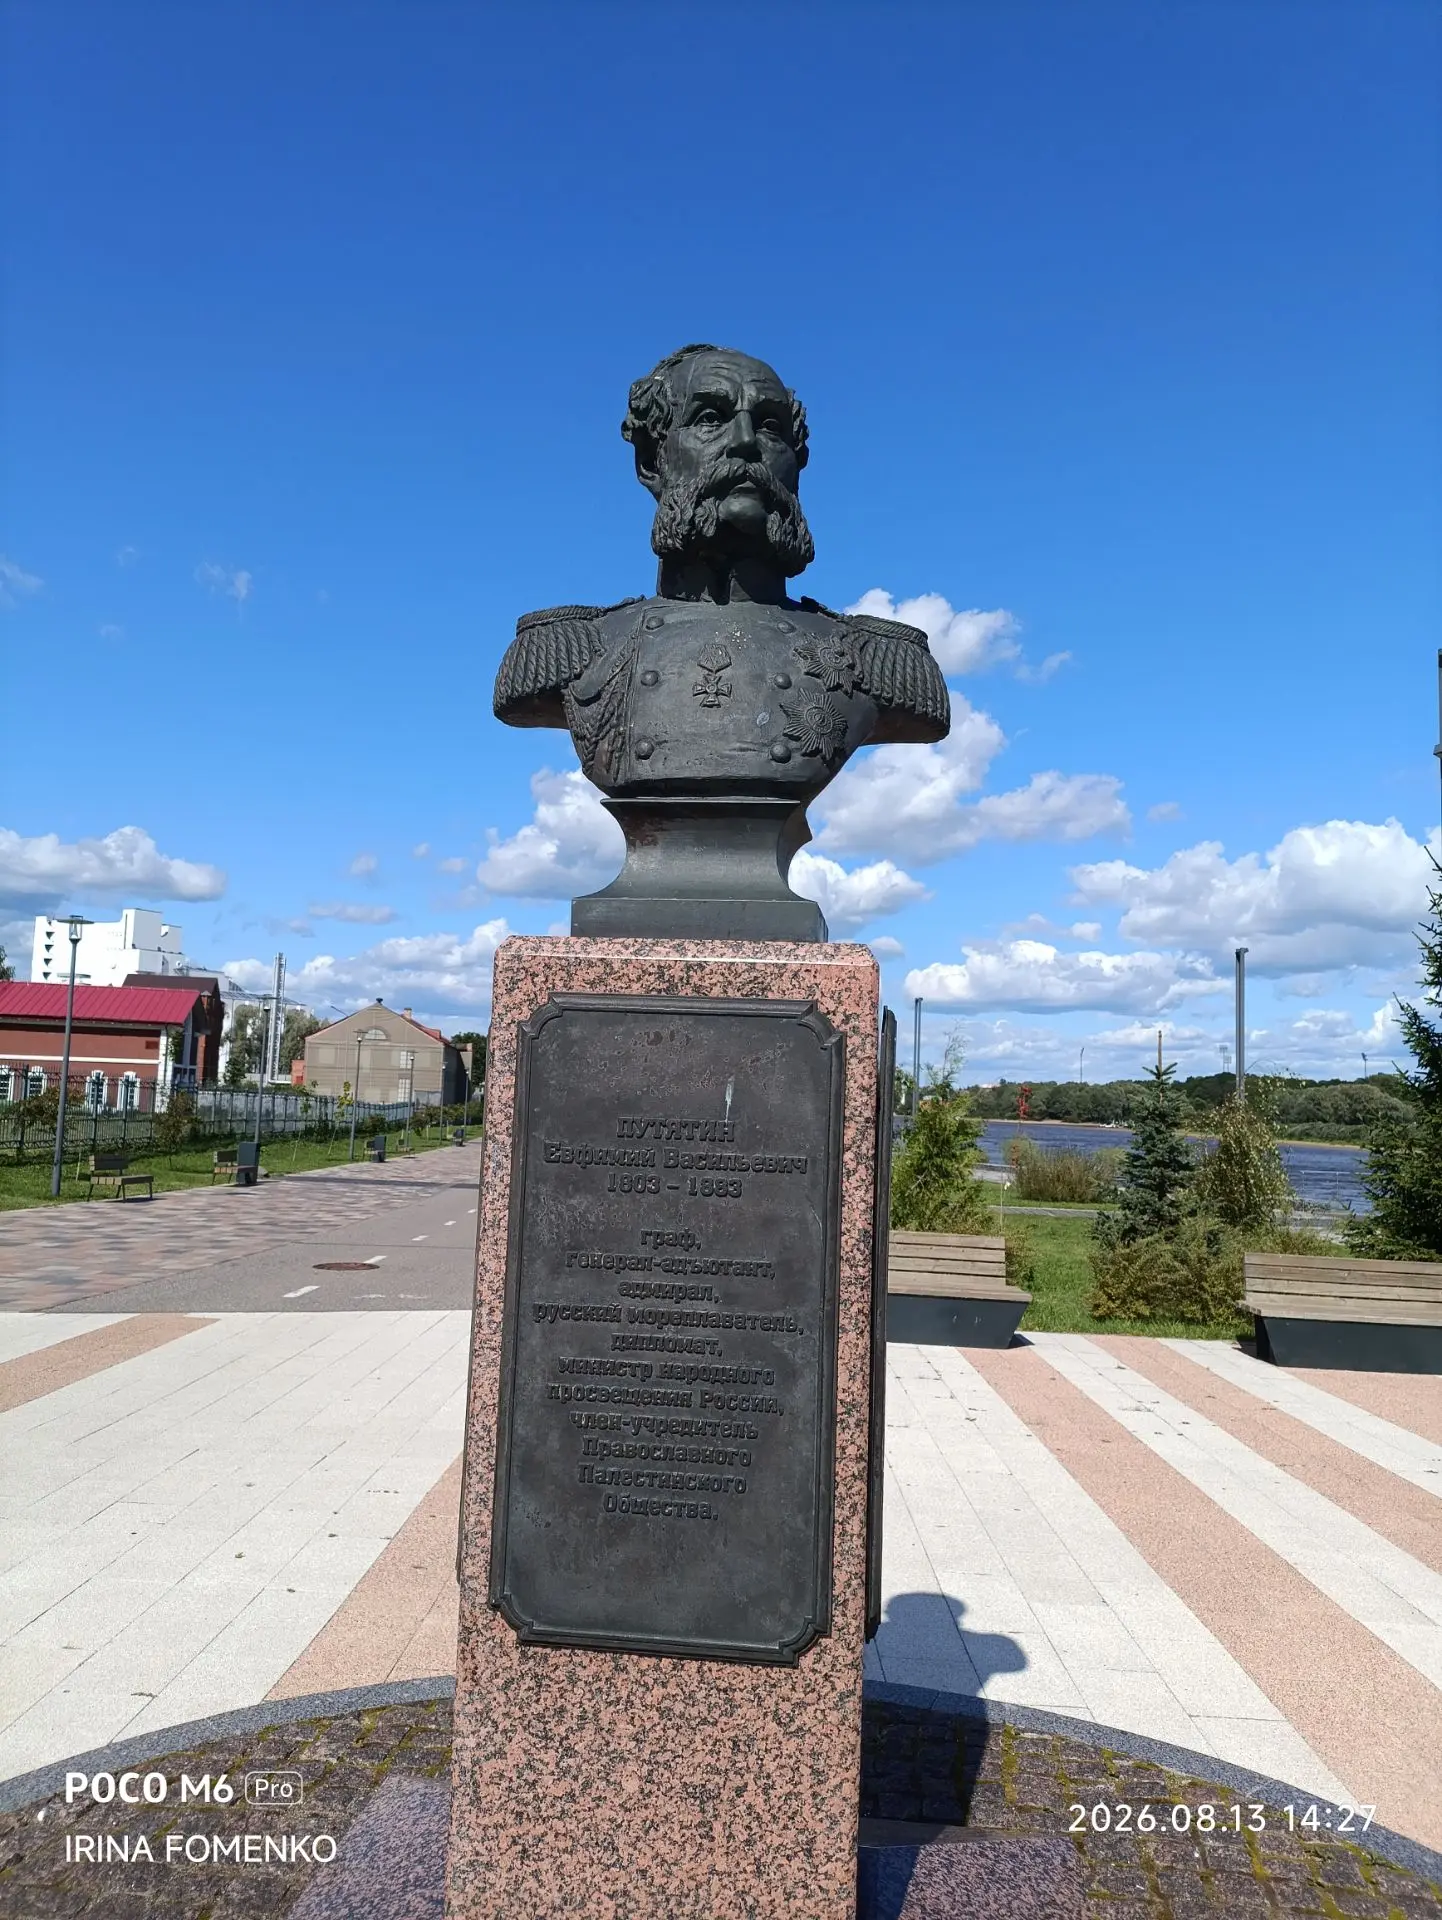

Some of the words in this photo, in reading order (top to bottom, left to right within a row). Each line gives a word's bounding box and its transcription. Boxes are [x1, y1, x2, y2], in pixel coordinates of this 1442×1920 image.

[616, 1116, 735, 1142] ПУТЯТИН
[543, 1141, 656, 1168] Евфимий
[663, 1148, 808, 1174] Васильевич
[607, 1173, 660, 1194] 1803
[687, 1176, 743, 1198] 1883
[640, 1228, 702, 1251] граф,
[565, 1252, 776, 1280] генерал-адъютант,
[617, 1281, 721, 1304] адмирал,
[532, 1302, 622, 1324] русский
[628, 1306, 804, 1336] мореплаватель,
[611, 1333, 723, 1357] дипломат,
[558, 1357, 653, 1382] министр
[660, 1361, 775, 1386] народного
[548, 1384, 693, 1409] просвещения
[700, 1390, 785, 1416] России,
[569, 1412, 759, 1440] член-учредитель
[581, 1436, 752, 1467] Православного
[577, 1463, 748, 1494] Палестинского
[603, 1493, 719, 1521] Общества.
